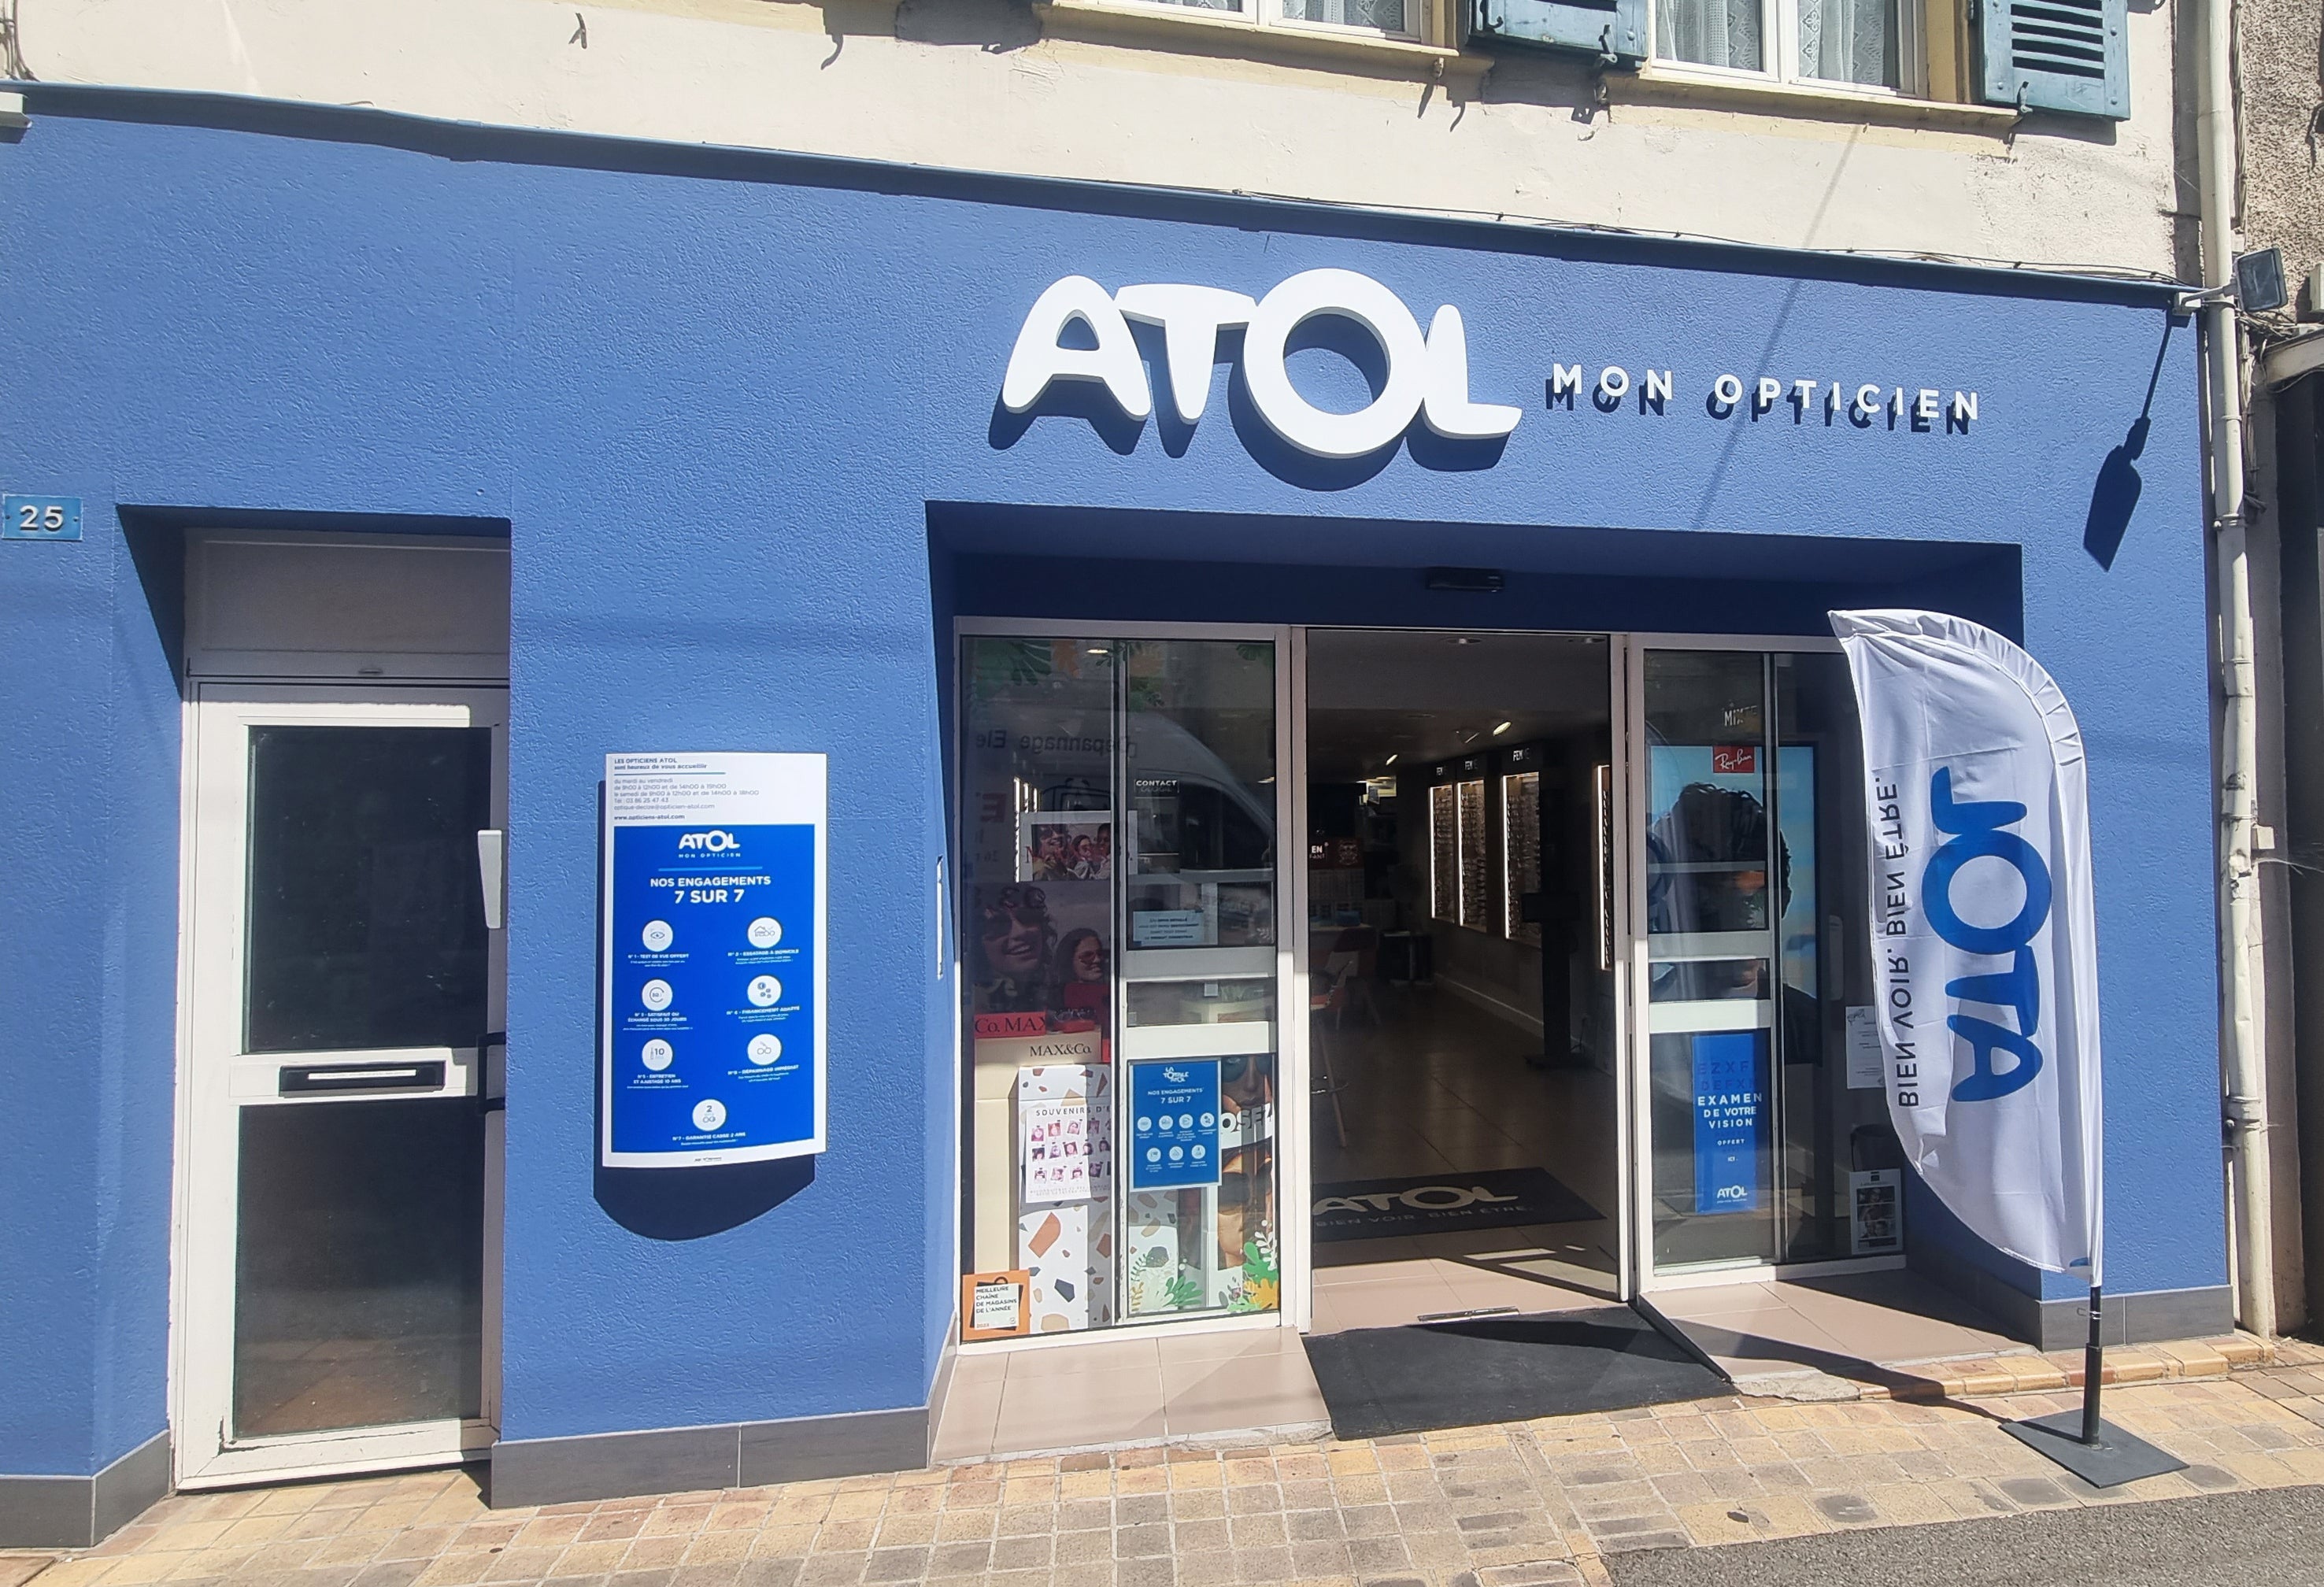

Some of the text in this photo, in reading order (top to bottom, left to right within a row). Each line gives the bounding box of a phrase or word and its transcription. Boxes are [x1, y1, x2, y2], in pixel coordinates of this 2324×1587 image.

[1002, 268, 1523, 459] ATOL
[1552, 363, 1978, 420] MON OPTICIEN
[19, 505, 64, 532] 25
[1715, 749, 1752, 770] Ray-Ban
[679, 830, 741, 853] ATOL
[650, 875, 771, 887] NOS ENGAGEMENTS
[675, 889, 745, 904] 7 SUR 7
[1697, 1093, 1763, 1106] EXAMEN
[1036, 1106, 1091, 1116] SOUVENIRS
[1704, 1106, 1756, 1118] DE VOTRE
[1708, 1118, 1752, 1129] VISION
[1717, 1185, 1748, 1198] ATOL
[1312, 1186, 1518, 1215] ATOL
